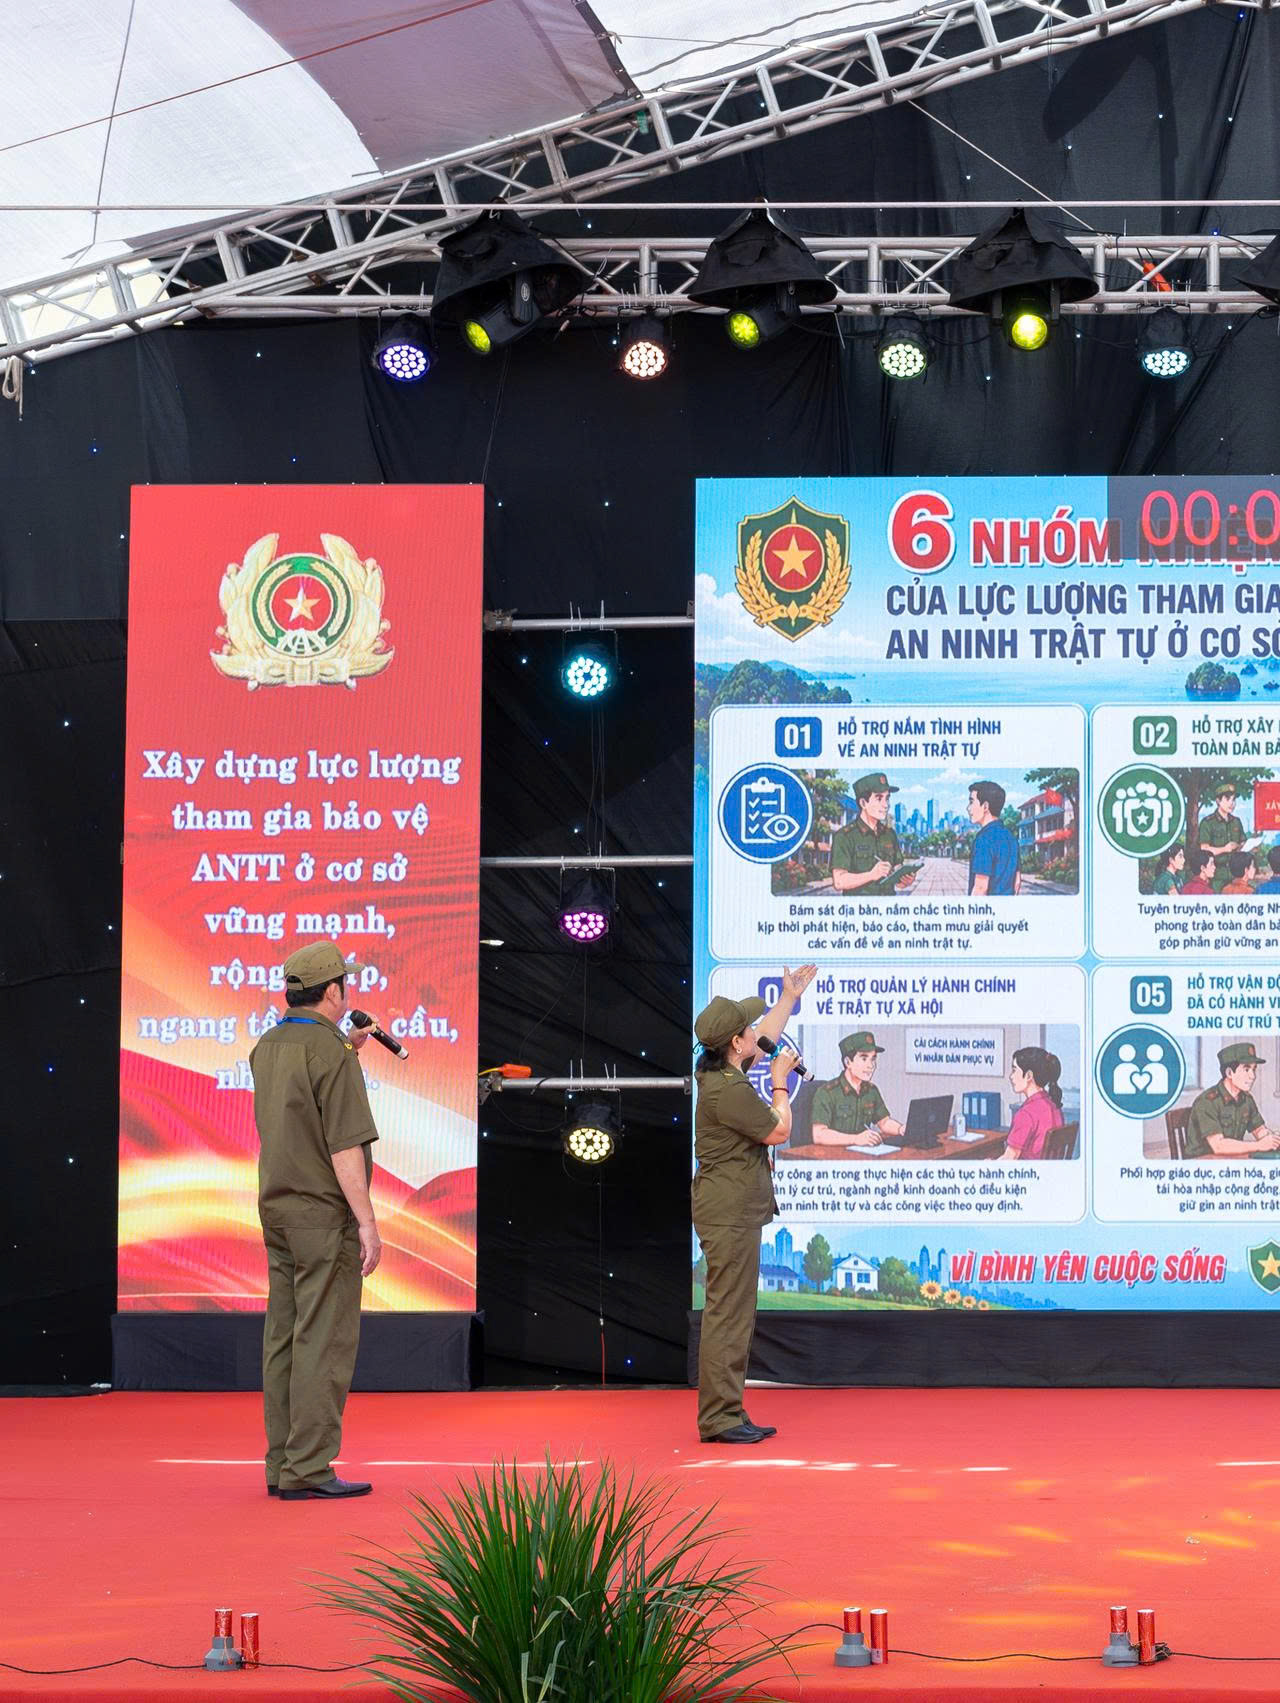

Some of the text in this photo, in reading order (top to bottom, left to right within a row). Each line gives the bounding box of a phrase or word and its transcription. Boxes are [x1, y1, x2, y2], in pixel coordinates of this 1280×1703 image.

[890, 492, 955, 571] 6
[971, 506, 1122, 566] NHÓM
[887, 577, 948, 616] CỦA
[959, 583, 1015, 620] LỰC
[1027, 582, 1127, 620] LƯỢNG
[1138, 584, 1224, 614] THAM
[886, 629, 928, 660] AN
[942, 629, 1019, 660] NINH
[1030, 623, 1107, 665] TRẬT
[1117, 625, 1159, 664] TỰ
[1168, 619, 1188, 658] Ở
[1199, 625, 1242, 658] CƠ
[784, 724, 810, 750] 01
[862, 720, 889, 738] TRỢ
[894, 716, 926, 735] NẮM
[930, 717, 962, 735] TÌNH
[967, 717, 1001, 735] HÌNH
[1140, 722, 1170, 748] 02
[1215, 718, 1243, 736] TRỢ
[1247, 716, 1274, 734] XÂY
[860, 743, 879, 758] AN
[884, 743, 918, 757] NINH
[922, 740, 957, 760] TRẬT
[961, 741, 981, 760] TỰ
[1192, 738, 1228, 756] TOÀN
[1232, 738, 1260, 756] DÂN
[143, 750, 462, 784] Xây dựng lực lượng
[172, 800, 428, 836] tham gia bảo vệ
[191, 852, 408, 882] ANTT ở cơ sở
[204, 905, 396, 942] vững mạnh,
[210, 959, 285, 991] rộng
[839, 978, 866, 996] TRỢ
[870, 976, 907, 994] QUẢN
[912, 976, 928, 993] LÝ
[932, 976, 970, 993] HÀNH
[974, 976, 1016, 993] CHÍNH
[1209, 976, 1234, 992] TRỢ
[1237, 974, 1263, 992] VẬN
[837, 998, 872, 1018] TRẬT
[876, 1000, 894, 1018] TỰ
[898, 998, 916, 1015] XÃ
[920, 998, 943, 1018] HỘI
[1136, 982, 1166, 1007] 05
[138, 1017, 236, 1044] ngang
[391, 1005, 458, 1043] cầu,
[951, 1247, 1226, 1287] VÌ BÌNH YÊN CUỘC SỐNG
